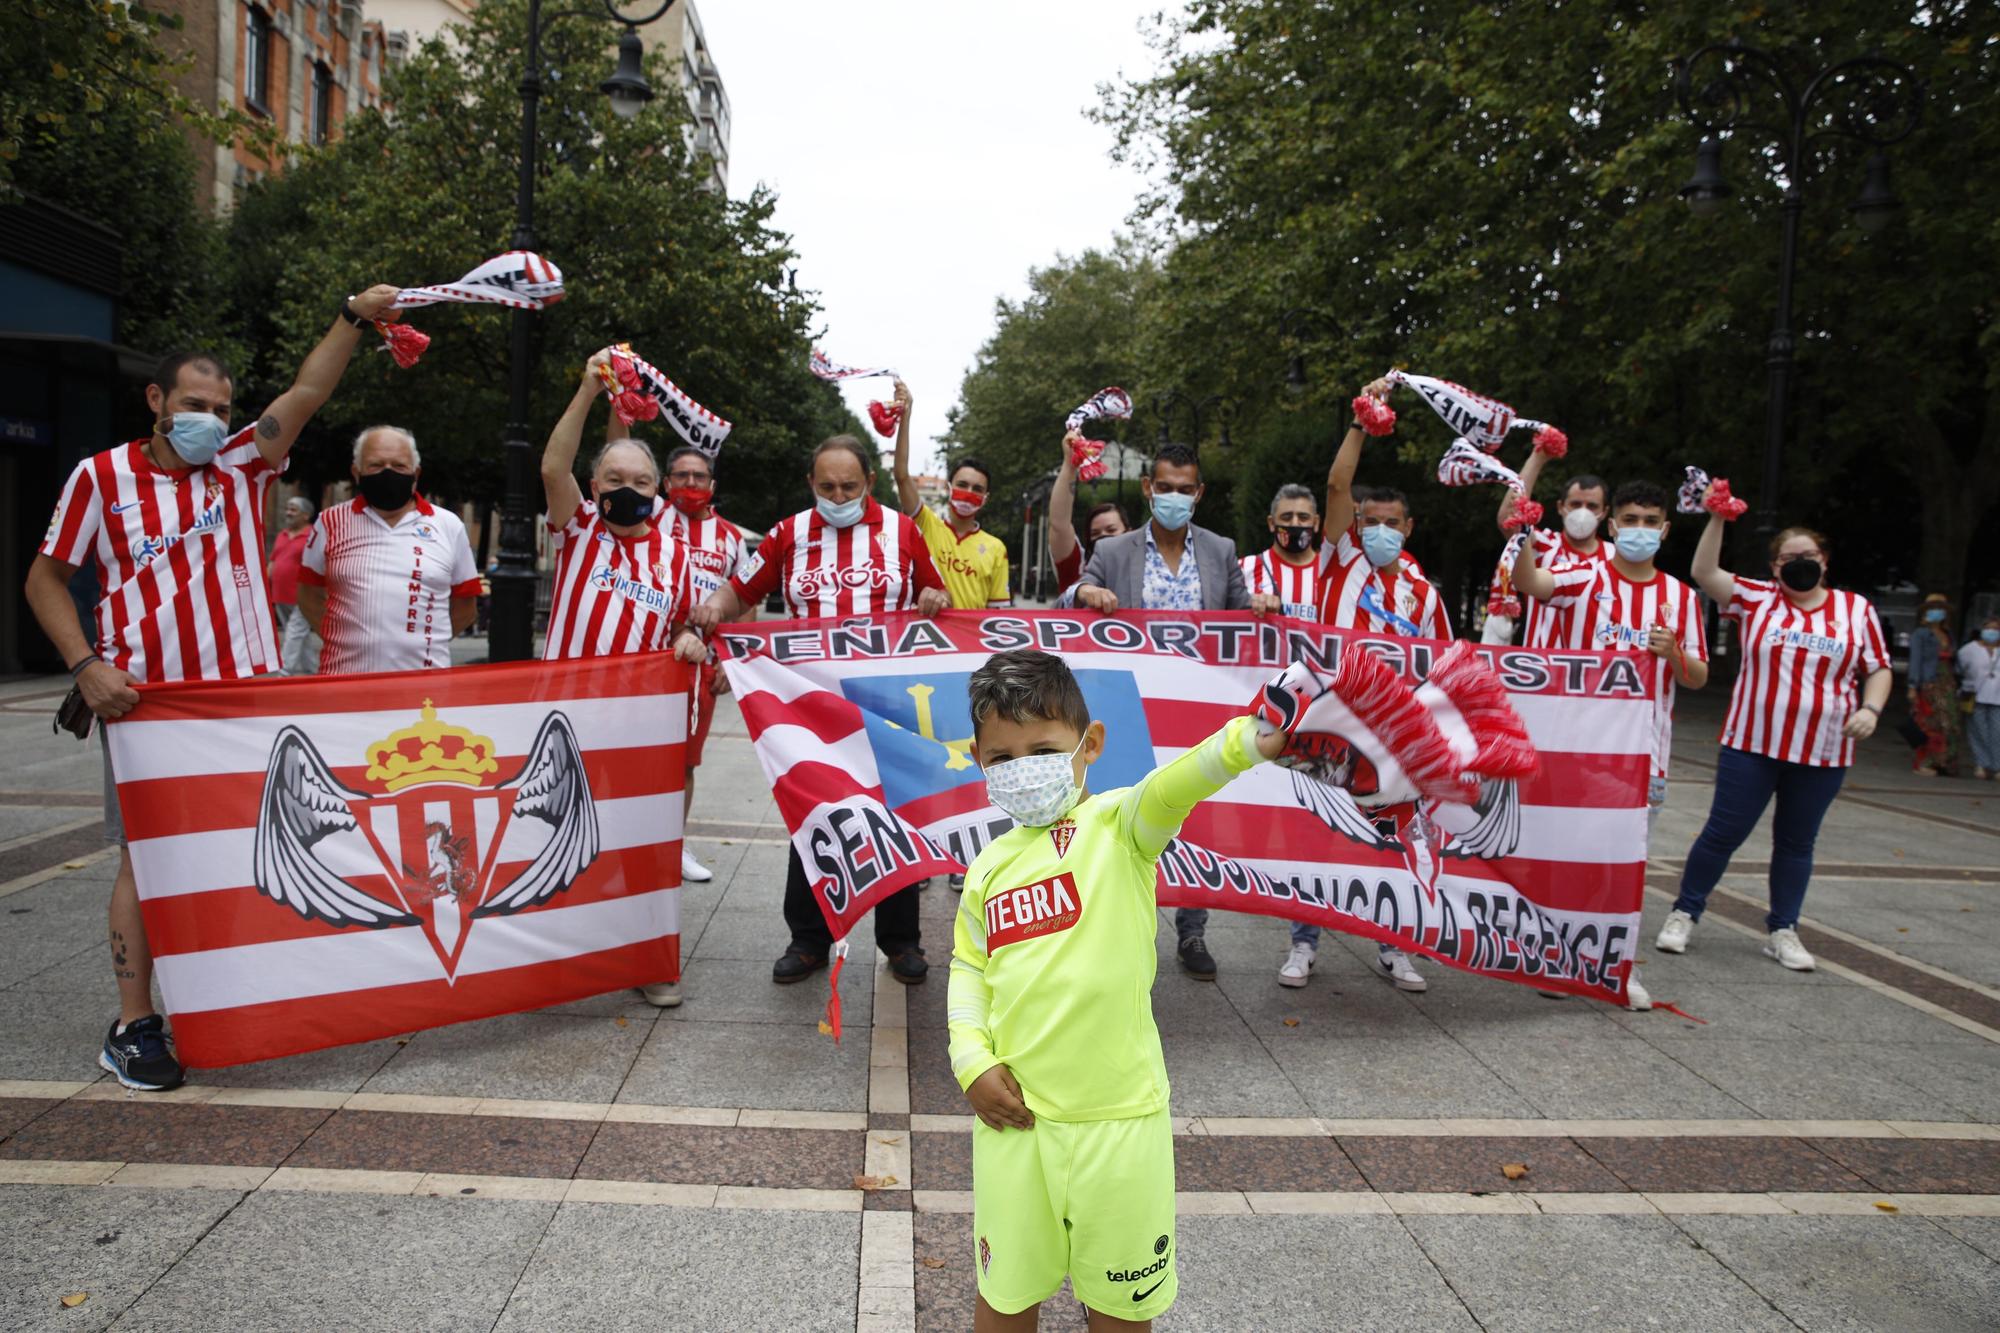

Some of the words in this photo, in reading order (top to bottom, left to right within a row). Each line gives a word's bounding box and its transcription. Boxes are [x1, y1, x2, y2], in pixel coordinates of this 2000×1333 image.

[406, 546, 423, 633] SIEMPRE
[615, 574, 671, 613] INTEGRA
[797, 558, 895, 600] gijón
[723, 618, 957, 659] PEÑA
[980, 617, 1646, 697] SPORTINGUSTA
[1785, 631, 1844, 655] INTEGRA
